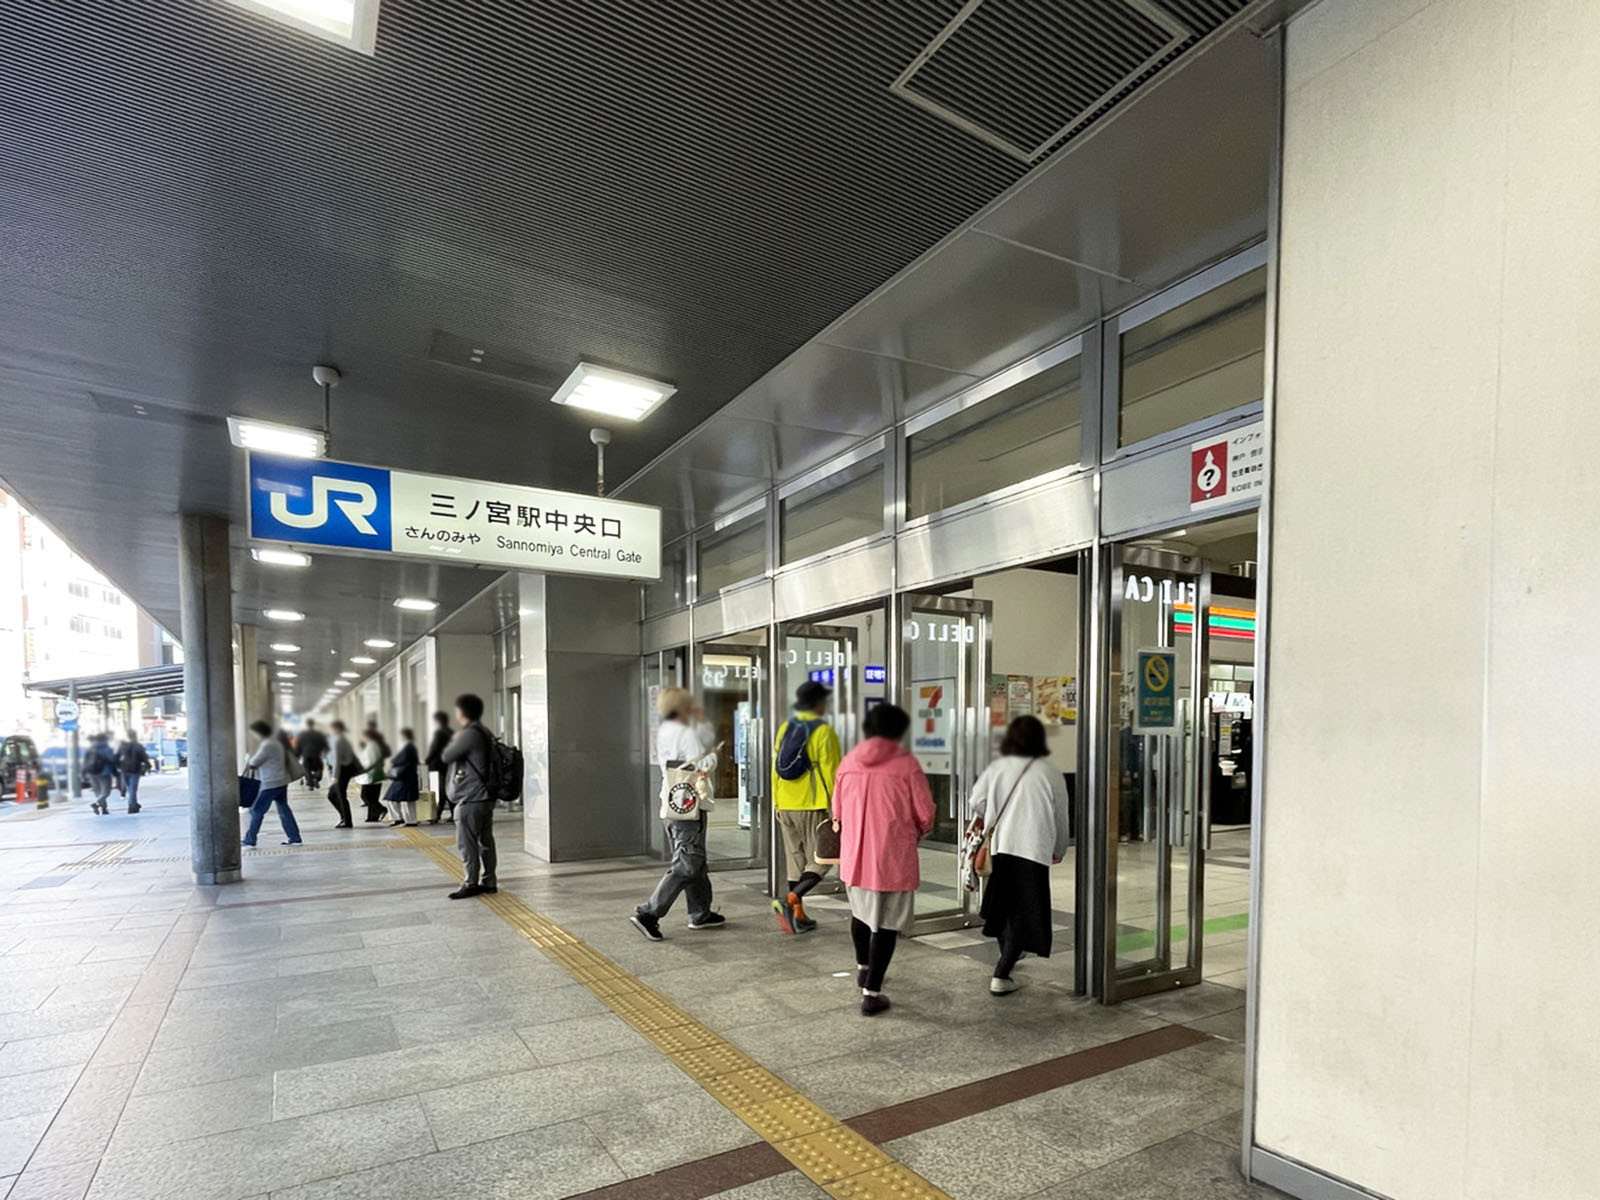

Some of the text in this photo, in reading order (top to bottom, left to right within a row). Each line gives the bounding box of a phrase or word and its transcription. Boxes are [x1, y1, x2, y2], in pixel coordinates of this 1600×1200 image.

[270, 475, 378, 535] JR
[430, 493, 621, 539] 三ノ宮駅中央口
[404, 526, 481, 544] さんのみや
[497, 535, 642, 564] Sannomiya Central Gate
